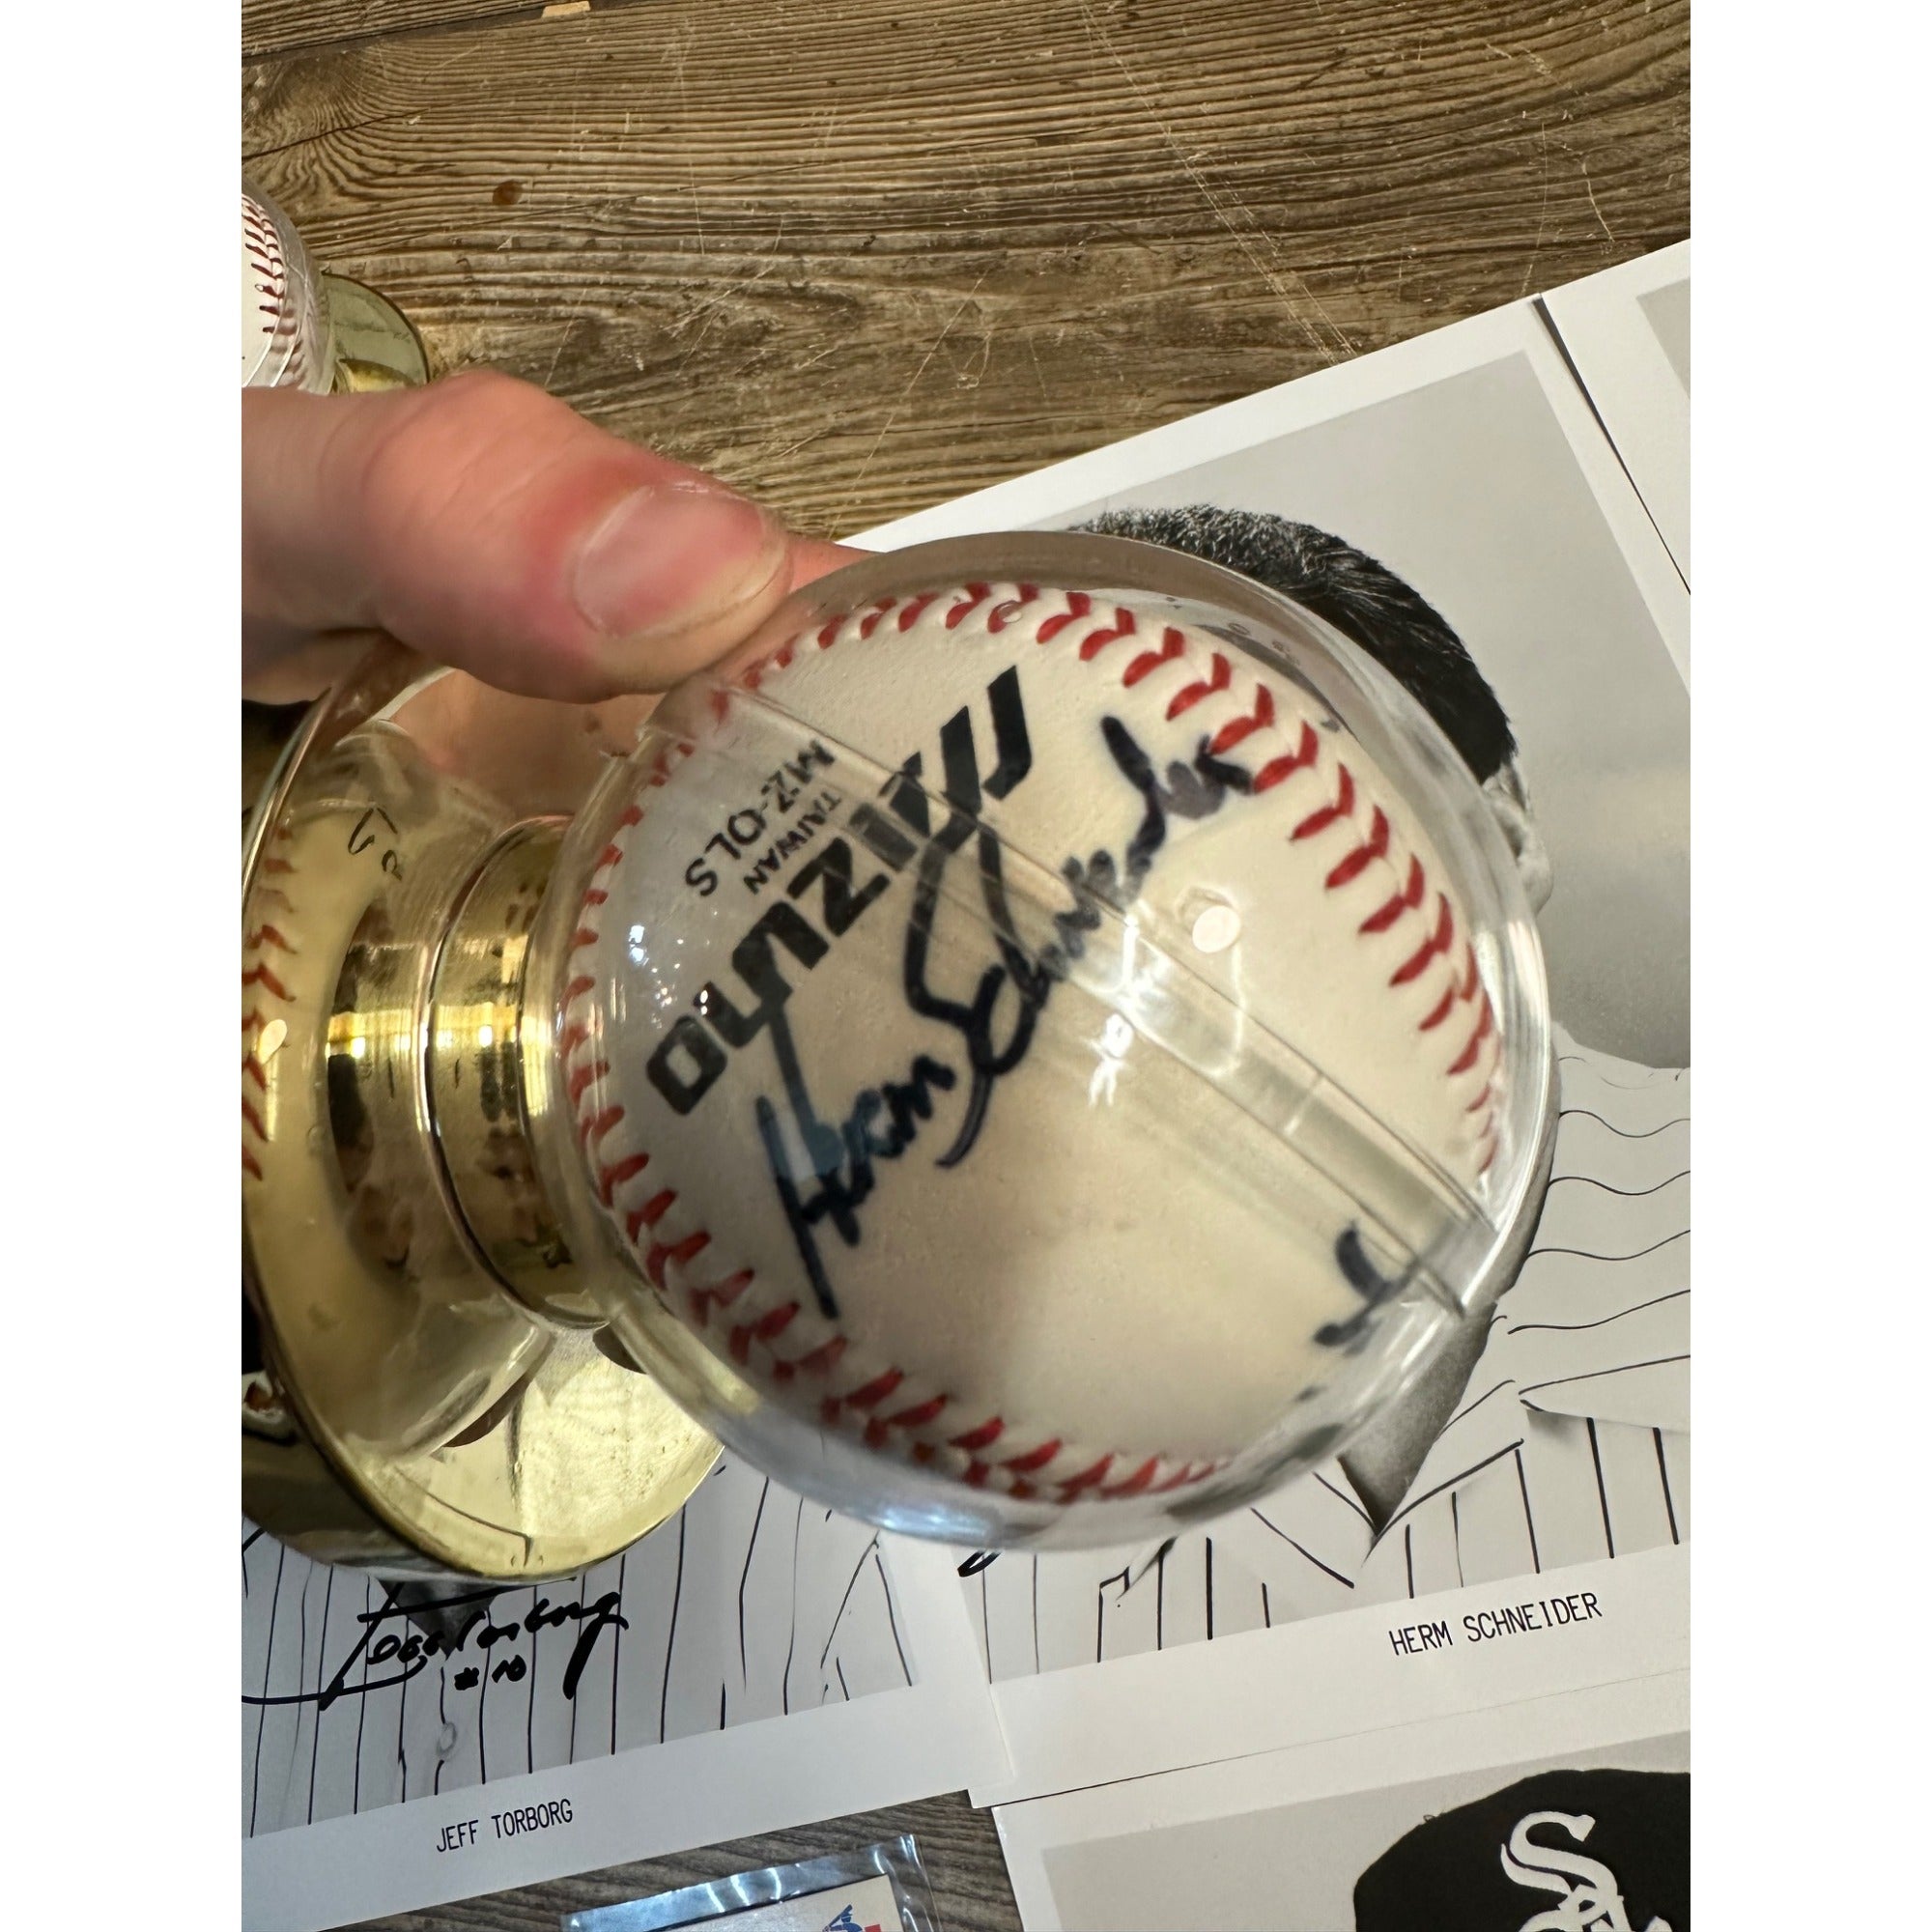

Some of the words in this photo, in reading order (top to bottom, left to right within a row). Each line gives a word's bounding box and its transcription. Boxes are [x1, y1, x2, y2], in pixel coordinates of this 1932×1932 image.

[743, 792, 841, 895] TAIWAN
[646, 665, 1032, 1116] MIZUNO
[1389, 1620, 1453, 1656] HERM
[1463, 1592, 1603, 1642] SCHNEIDER
[437, 1819, 479, 1853] JEFF
[491, 1798, 573, 1839] TORBORG
